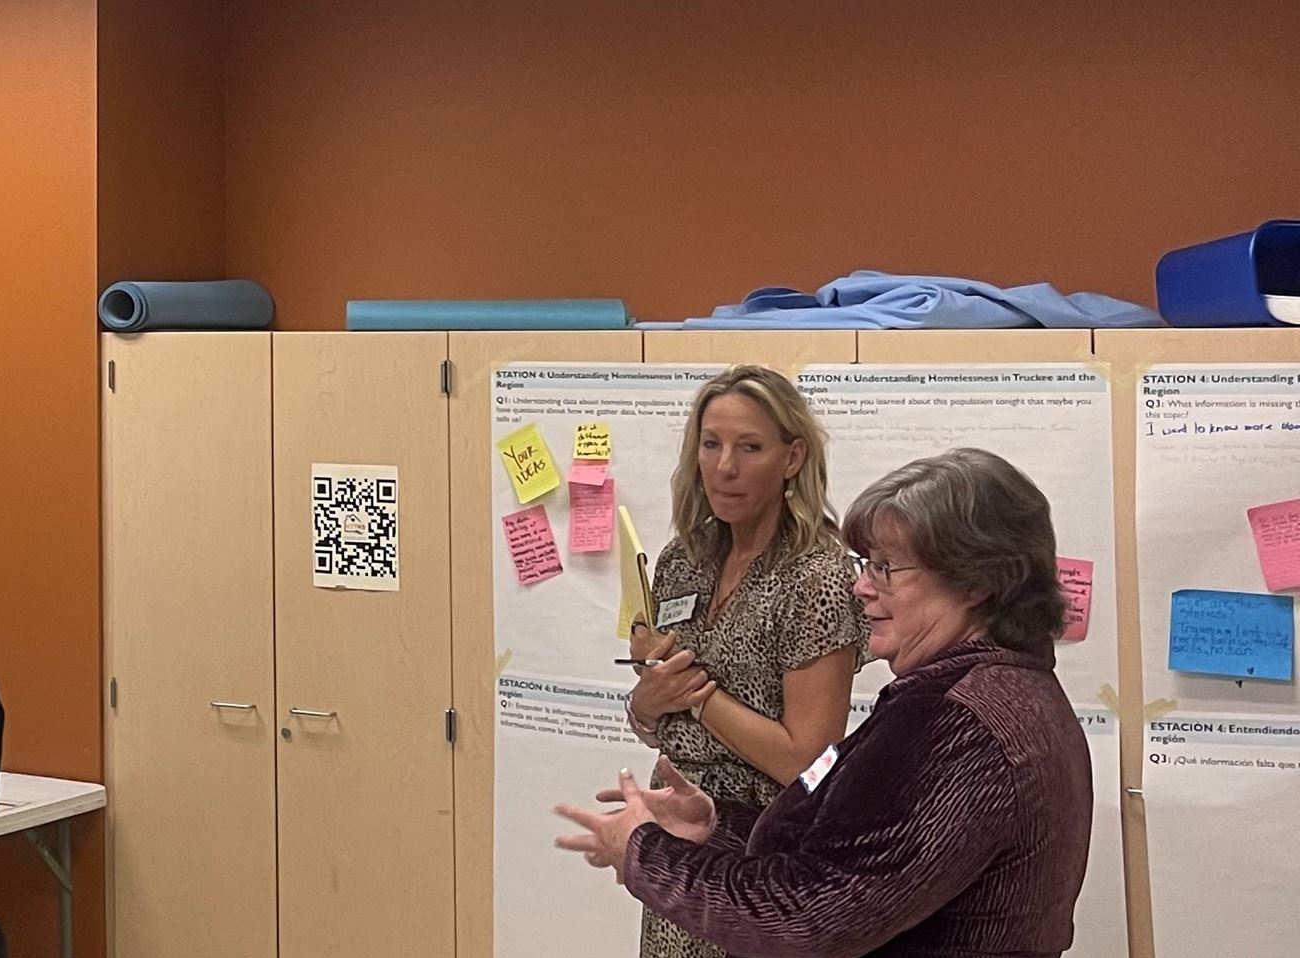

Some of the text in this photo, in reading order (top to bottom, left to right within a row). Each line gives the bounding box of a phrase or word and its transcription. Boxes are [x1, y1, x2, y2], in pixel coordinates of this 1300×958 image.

[496, 371, 536, 379] STATION
[538, 371, 546, 379] 4:
[547, 371, 610, 382] Understanding
[611, 372, 672, 381] Homelessness
[674, 372, 683, 380] in
[798, 373, 1096, 384] STATION 4: Understanding Homelessness in Truckee and the
[1143, 375, 1196, 384] STATION
[1200, 375, 1209, 383] 4:
[1211, 375, 1294, 385] Understanding
[496, 381, 524, 389] Region
[797, 385, 828, 395] Region
[1143, 387, 1180, 397] Region
[817, 397, 839, 406] What
[840, 398, 857, 406] have
[859, 399, 874, 407] you
[876, 398, 906, 406] learned
[933, 397, 948, 405] this
[950, 397, 994, 408] population
[995, 397, 1025, 407] tonight
[1027, 397, 1044, 405] that
[1046, 397, 1073, 407] maybe
[1167, 400, 1192, 408] What
[1194, 400, 1247, 408] information
[1249, 400, 1256, 408] is
[1259, 400, 1293, 410] missing
[827, 408, 848, 416] know
[1145, 411, 1160, 419] this
[1209, 423, 1238, 434] know
[503, 445, 539, 470] YOUR
[515, 460, 546, 485] IDEAS
[499, 678, 543, 691] ESTACIÓN
[552, 686, 605, 699] Entendiendo
[606, 692, 615, 701] la
[499, 689, 523, 699] región
[1086, 716, 1094, 725] y
[1096, 714, 1106, 724] la
[1217, 725, 1227, 733] 4:
[1229, 725, 1300, 736] Entendiendo
[1150, 734, 1186, 745] región
[1149, 753, 1171, 765] Q3:
[1200, 757, 1254, 767] información
[1256, 759, 1275, 768] falta
[1278, 761, 1296, 770] que
